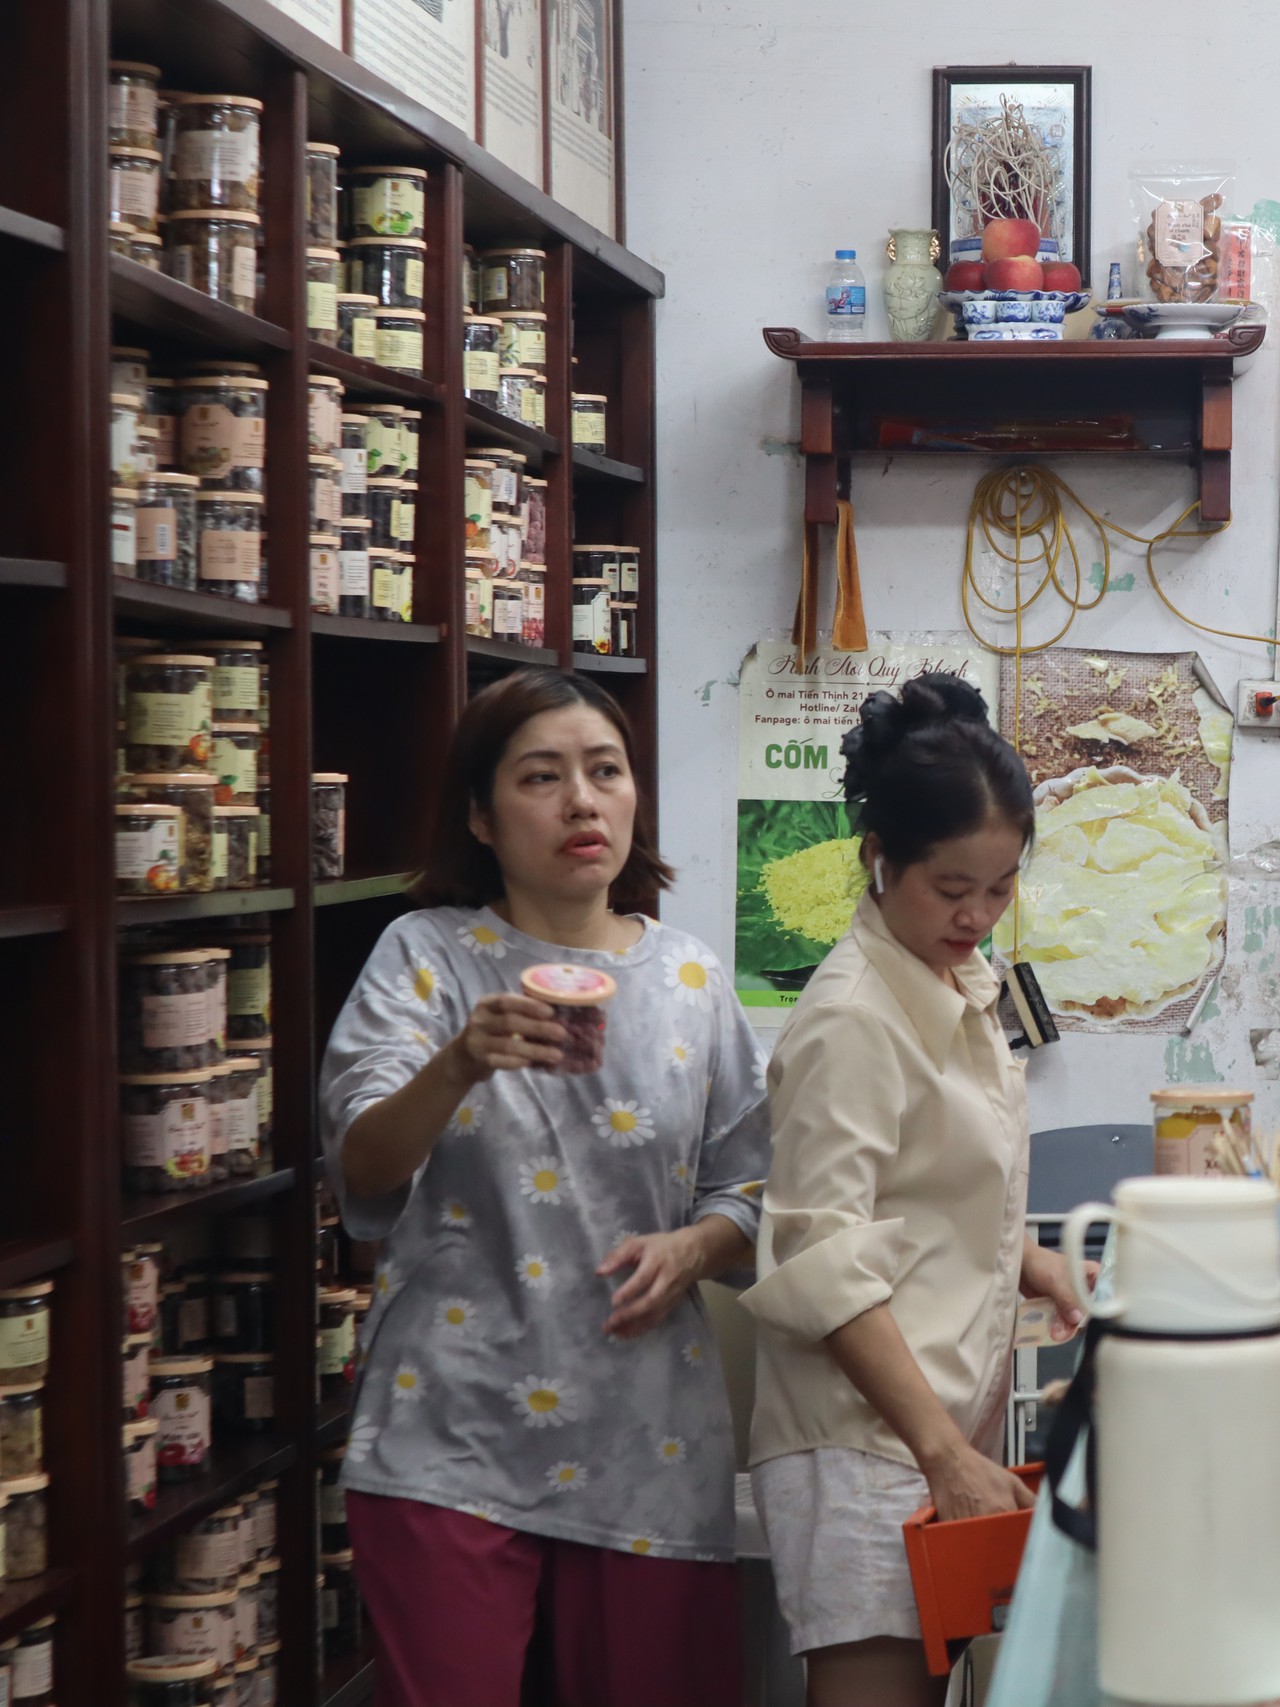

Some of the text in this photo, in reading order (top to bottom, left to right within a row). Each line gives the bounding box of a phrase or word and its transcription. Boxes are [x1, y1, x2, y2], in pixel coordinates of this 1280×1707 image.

[868, 656, 900, 688] Quý
[765, 688, 775, 699] Ô
[778, 691, 795, 699] mai
[798, 689, 819, 699] Tiến
[822, 690, 849, 702] Thịnh
[851, 691, 864, 700] 21
[799, 703, 841, 713] Hotline/
[755, 714, 801, 726] Fanpage:
[803, 716, 811, 725] ô
[813, 716, 831, 725] mai
[834, 715, 853, 726] tiến
[765, 738, 828, 769] CỐM
